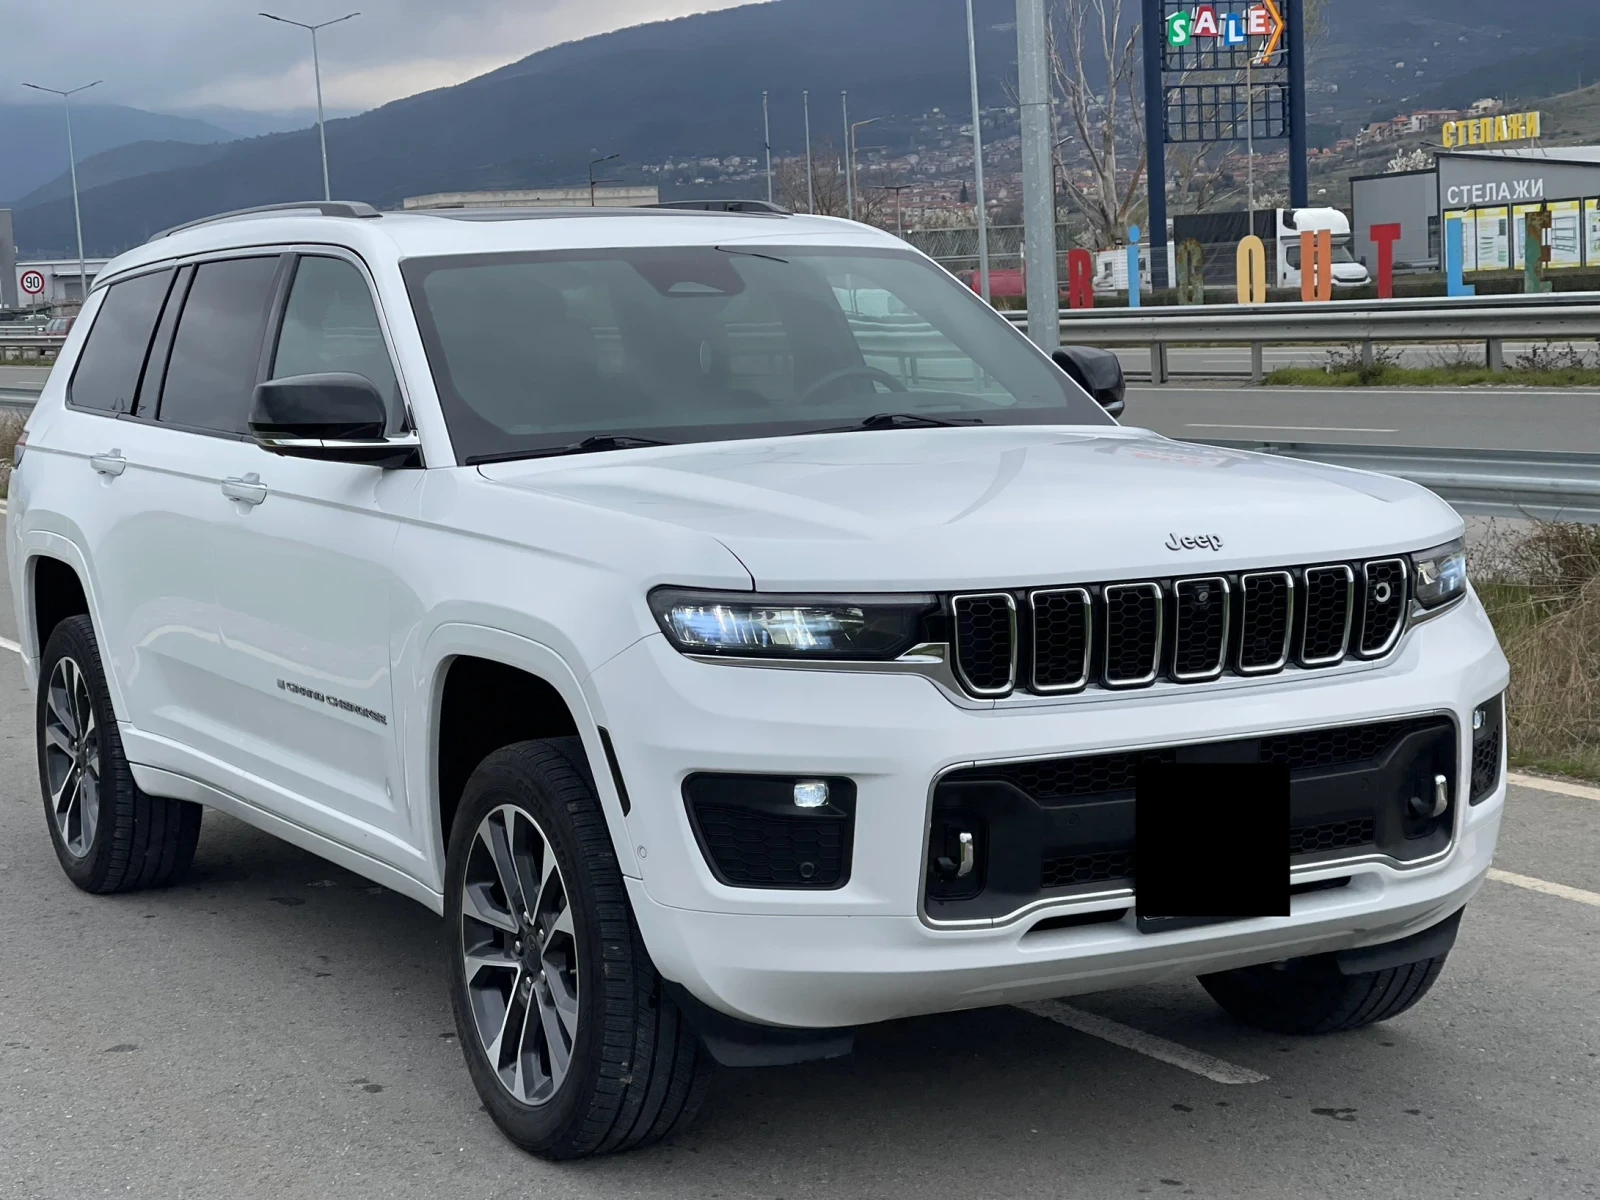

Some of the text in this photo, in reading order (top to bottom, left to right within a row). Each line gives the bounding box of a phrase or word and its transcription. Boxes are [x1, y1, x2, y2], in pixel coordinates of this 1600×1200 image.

[1172, 9, 1266, 43] SALE
[1442, 111, 1540, 148] СТЕЛАЖИ
[1447, 178, 1544, 204] СТЕЛАЖИ
[25, 276, 40, 289] 90
[1165, 532, 1224, 552] Jeep
